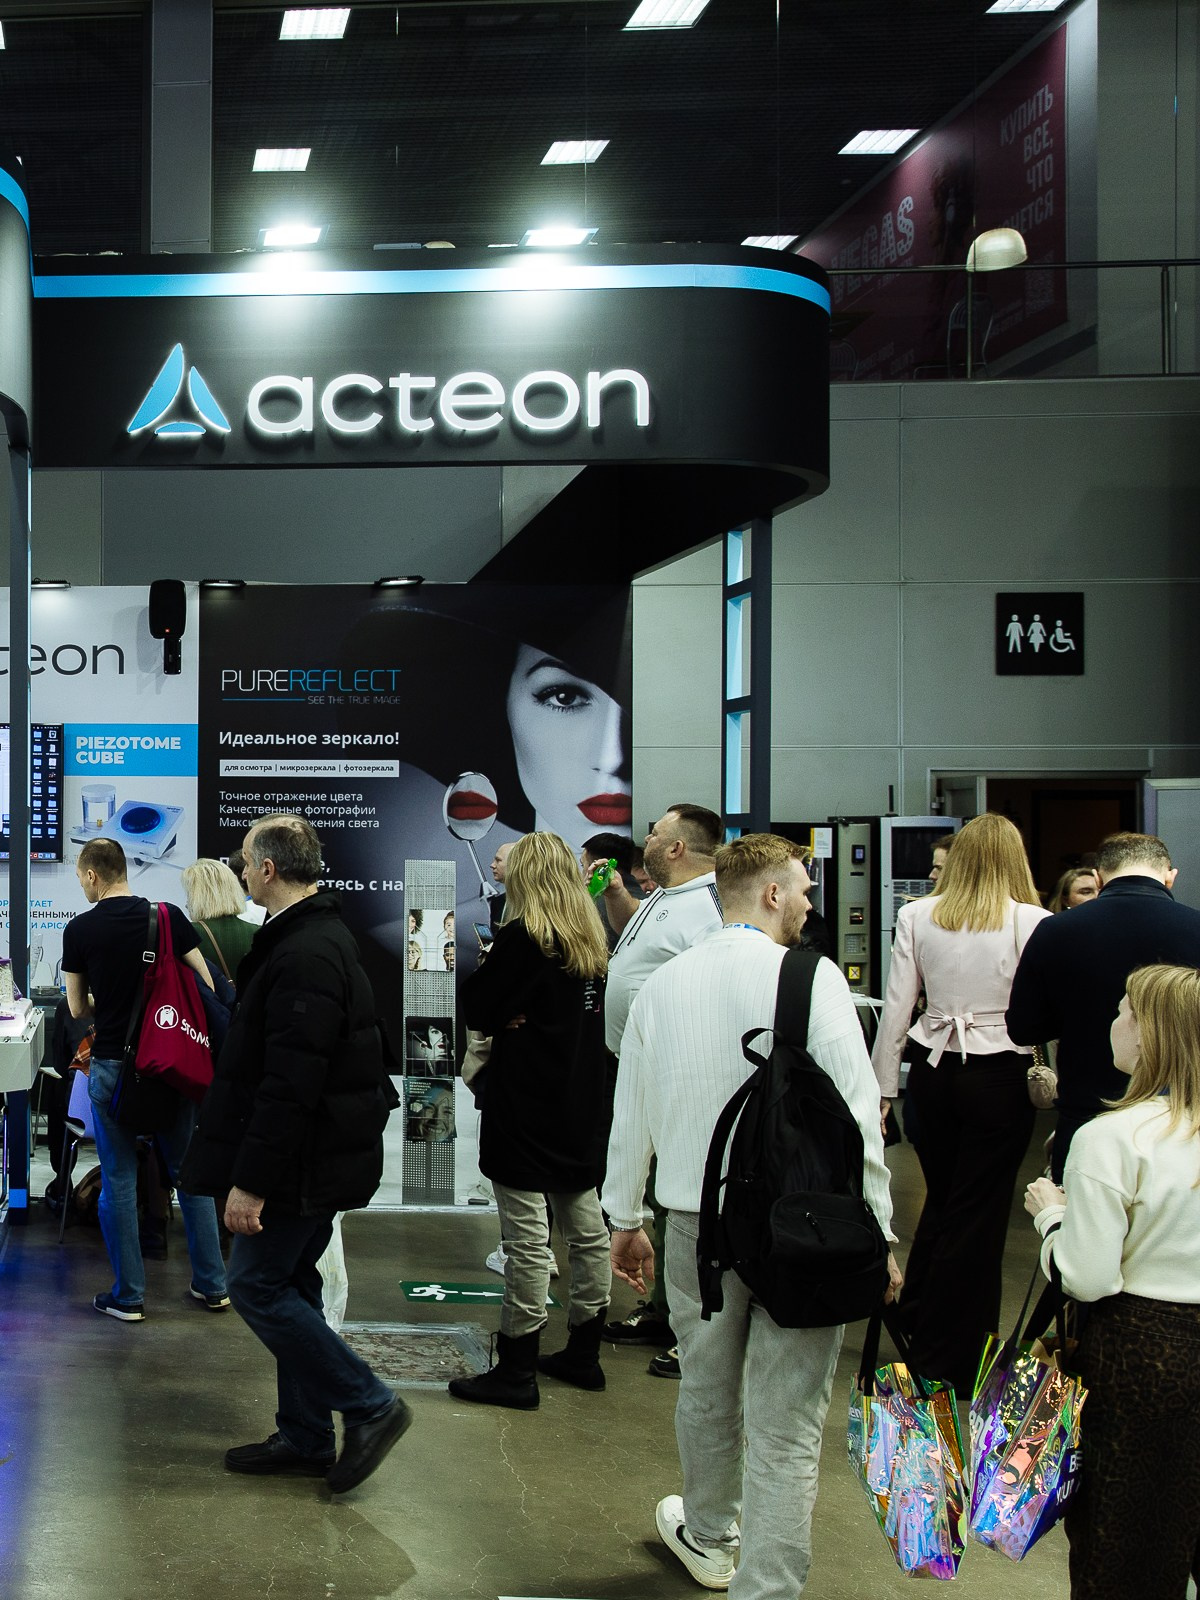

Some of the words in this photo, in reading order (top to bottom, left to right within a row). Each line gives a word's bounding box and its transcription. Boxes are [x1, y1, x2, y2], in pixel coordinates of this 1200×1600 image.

[999, 84, 1053, 146] КУПИТЬ
[1027, 154, 1053, 192] ЧТО
[831, 196, 915, 304] VEGAS
[247, 366, 650, 433] acteon
[221, 669, 401, 692] PUREREFLECT
[307, 695, 325, 705] SEE
[327, 695, 344, 705] THE
[349, 695, 370, 705] TRUE
[373, 695, 401, 705] IMAGE
[76, 736, 181, 750] PIEZOTOME
[219, 731, 317, 748] Идеальное
[321, 731, 400, 749] зеркало!
[75, 751, 125, 765] CUBE
[224, 764, 238, 773] для
[240, 764, 273, 773] осмотра
[279, 764, 336, 773] микрозеркала
[343, 764, 394, 774] фотозеркала
[219, 791, 261, 801] Точное
[263, 792, 327, 804] отражение
[330, 792, 363, 803] цвета
[219, 804, 302, 814] Качественные
[304, 804, 376, 817] фотографии
[309, 819, 345, 828] жения
[348, 819, 380, 828] света
[317, 879, 364, 891] етесь
[369, 881, 378, 891] с
[383, 881, 403, 891] на
